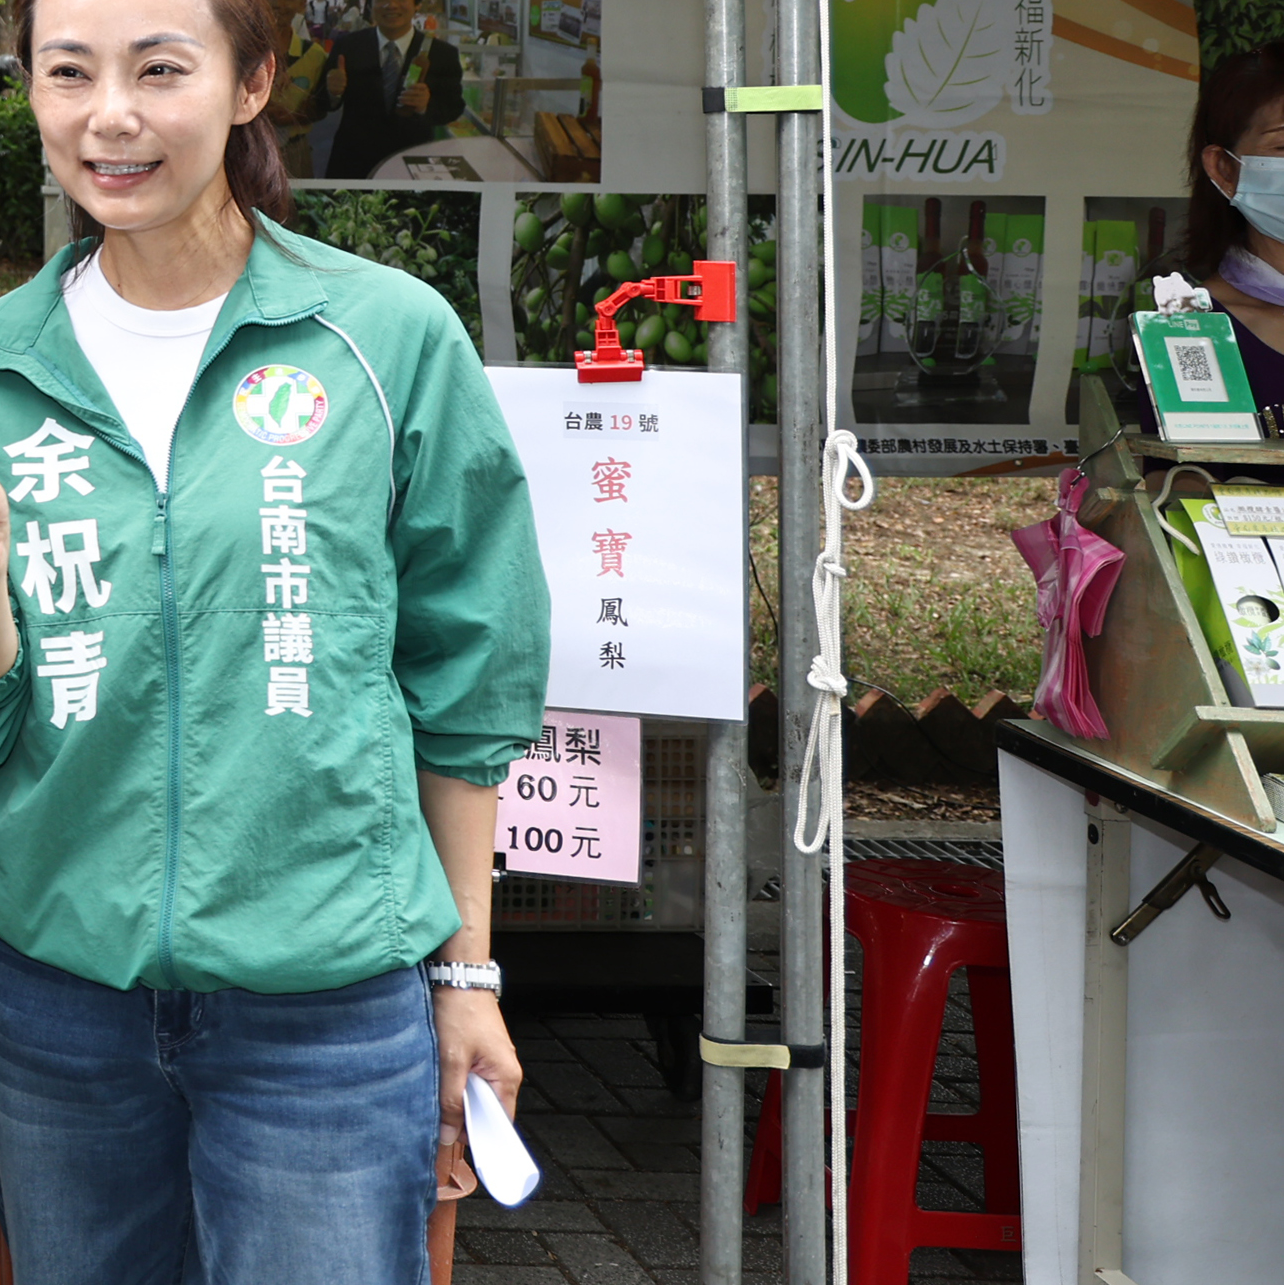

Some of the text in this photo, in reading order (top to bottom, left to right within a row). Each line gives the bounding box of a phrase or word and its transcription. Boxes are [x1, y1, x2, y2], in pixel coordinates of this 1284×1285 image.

[564, 411, 603, 433] 台農
[609, 413, 633, 432] 19
[260, 455, 313, 718] 台南市議員
[525, 725, 601, 766] 鳳梨
[517, 773, 600, 809] 60 元
[507, 825, 602, 859] 100 元
